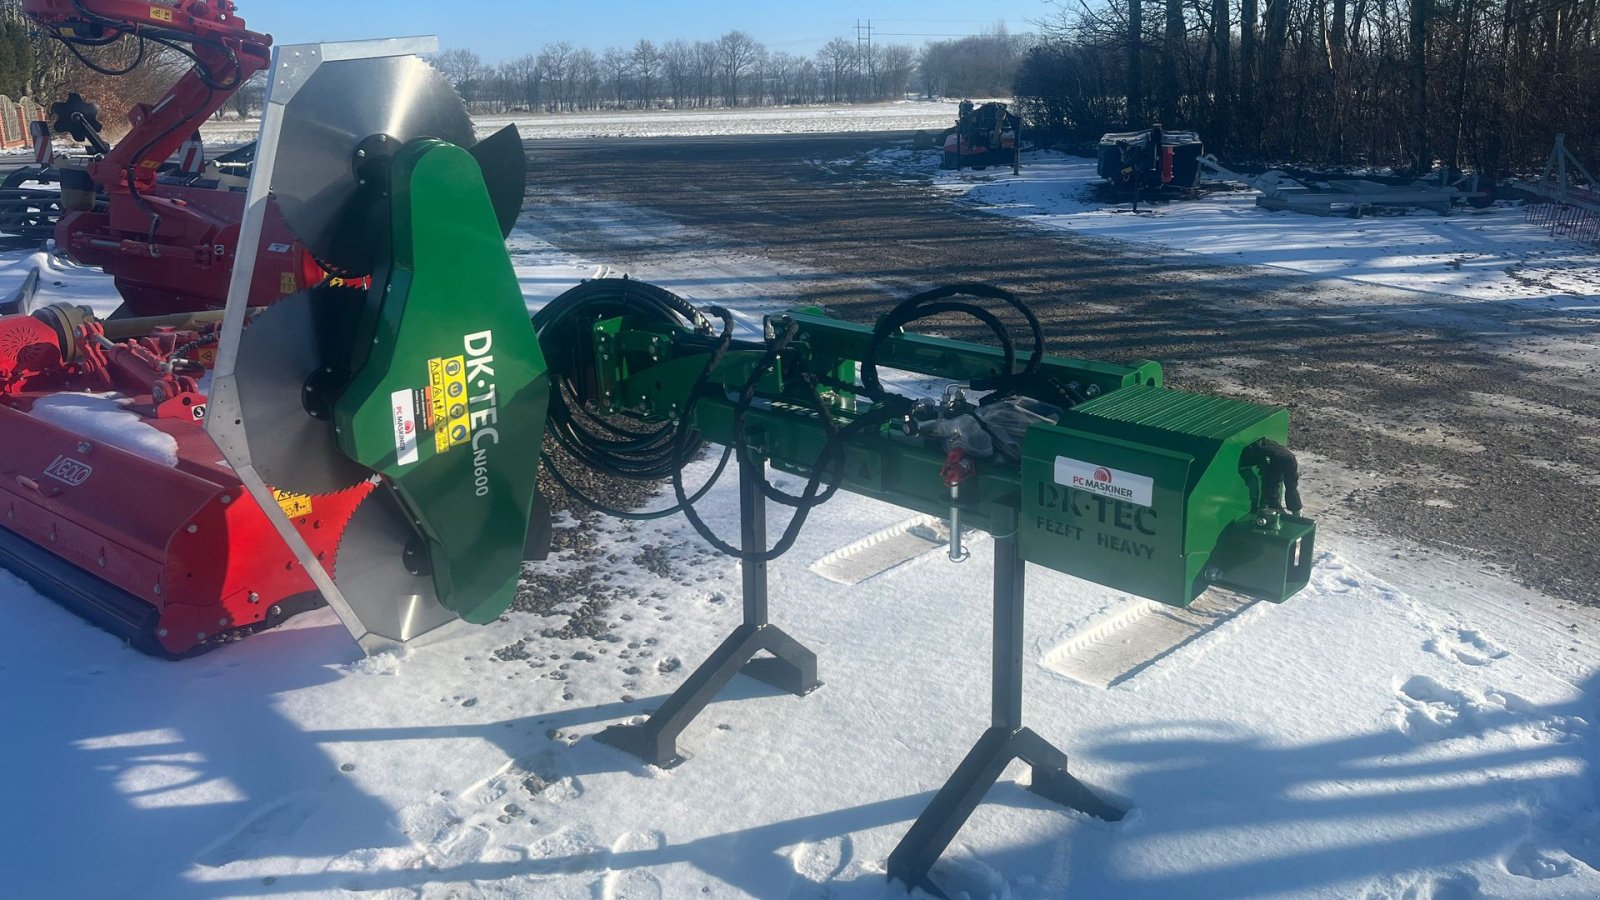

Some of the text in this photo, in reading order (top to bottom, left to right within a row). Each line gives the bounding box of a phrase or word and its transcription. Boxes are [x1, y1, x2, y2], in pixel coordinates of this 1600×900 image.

[396, 406, 403, 416] PC
[397, 416, 405, 451] MASKINER
[473, 450, 488, 497] NJ600
[1073, 475, 1084, 487] PC
[1085, 479, 1133, 499] MASKINER
[1037, 516, 1156, 560] FEZFT HEAVY
